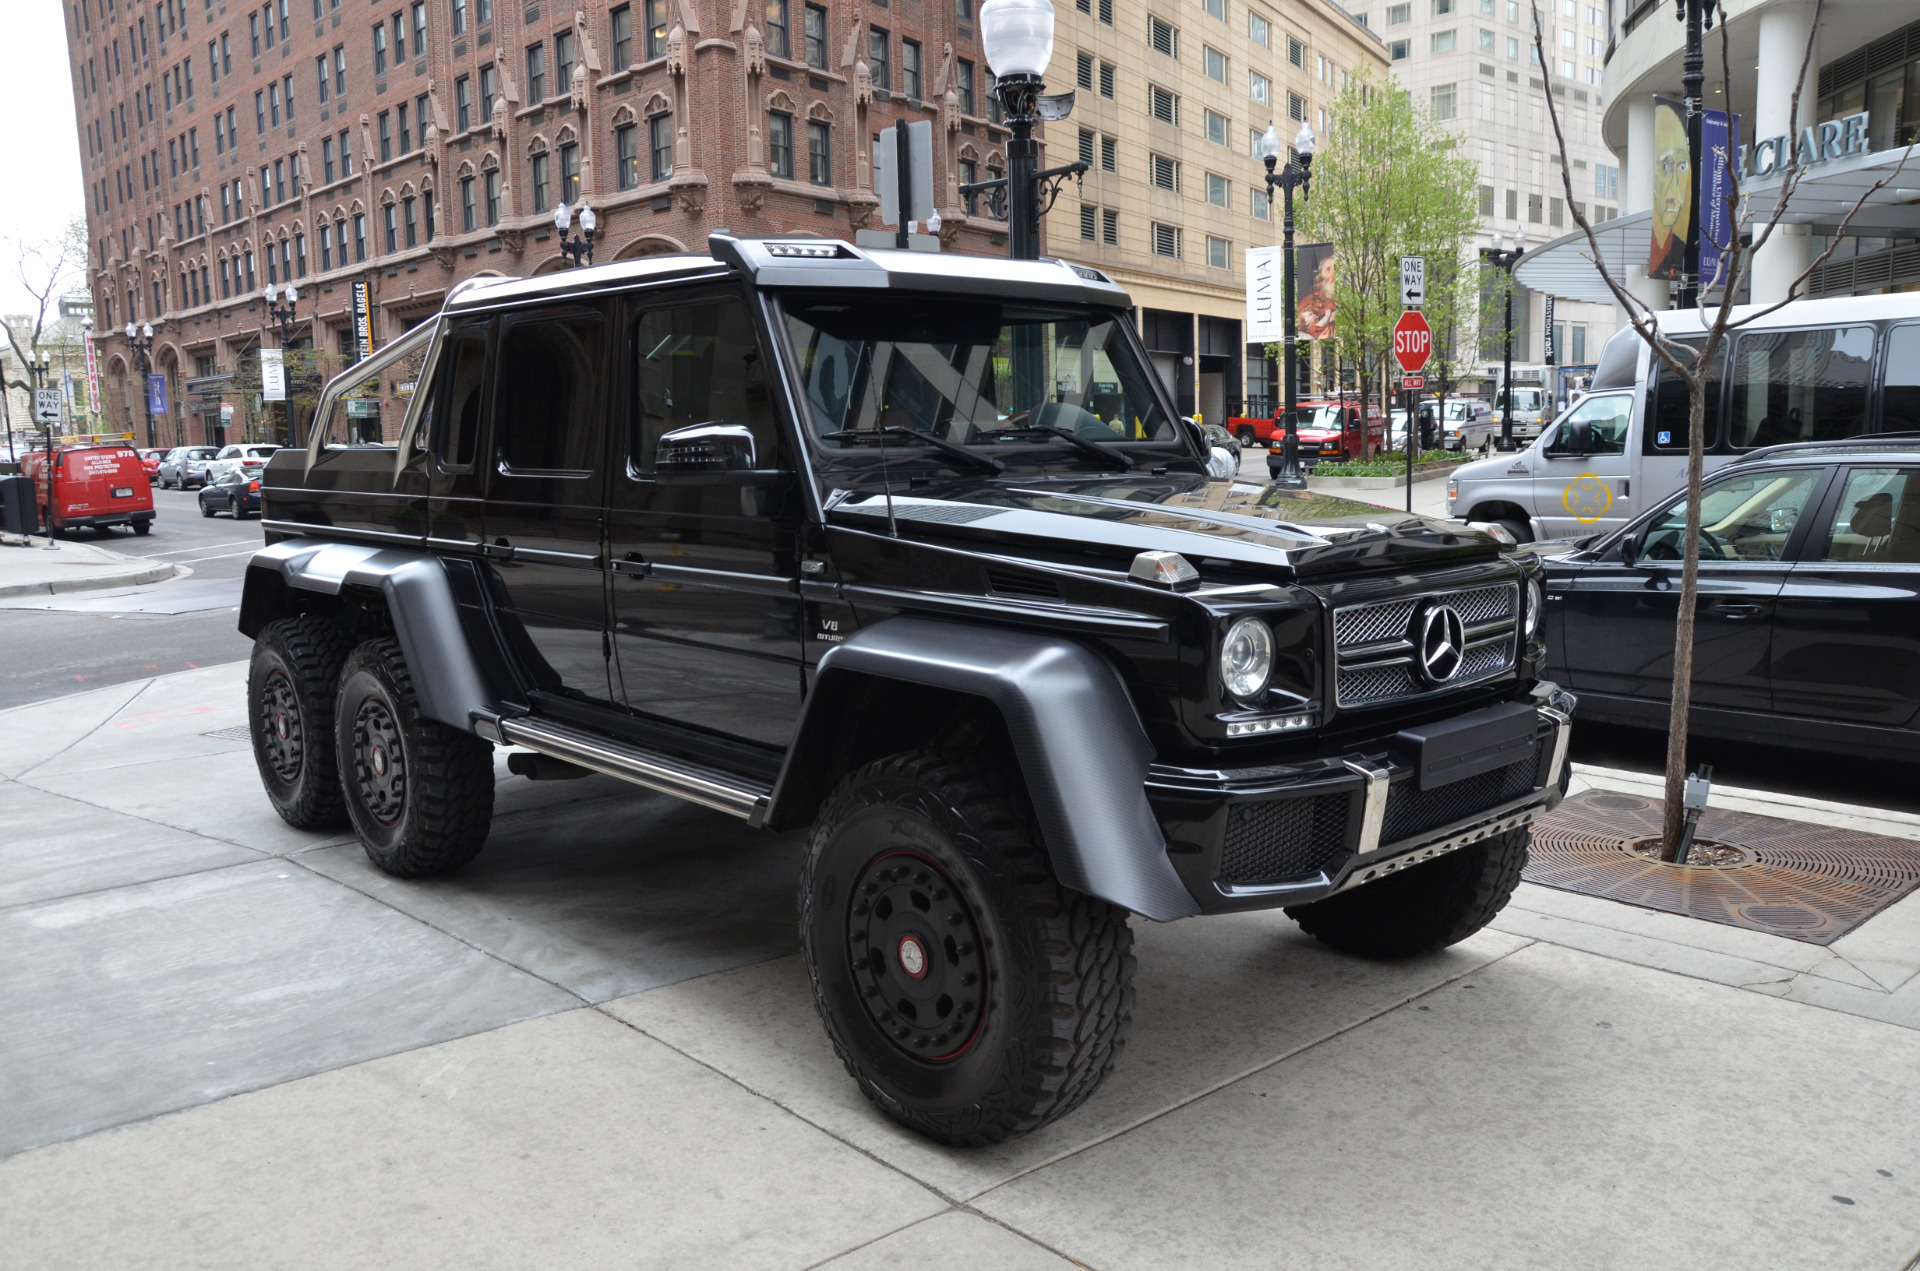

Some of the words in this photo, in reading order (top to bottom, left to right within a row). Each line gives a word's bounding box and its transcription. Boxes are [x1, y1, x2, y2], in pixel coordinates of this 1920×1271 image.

[1750, 111, 1870, 177] CLARE
[1404, 261, 1422, 273] ONE
[1403, 274, 1422, 286] WAY
[1256, 259, 1272, 323] LUMA
[355, 283, 367, 314] BAGELS
[357, 315, 369, 337] BROS.
[1396, 330, 1429, 353] STOP
[1545, 337, 1554, 357] rack
[1404, 377, 1413, 387] ALL
[1413, 377, 1422, 387] WAY
[39, 391, 59, 401] ONE
[38, 401, 59, 409] WAY
[117, 450, 135, 458] 978
[817, 633, 846, 642] BITURB
